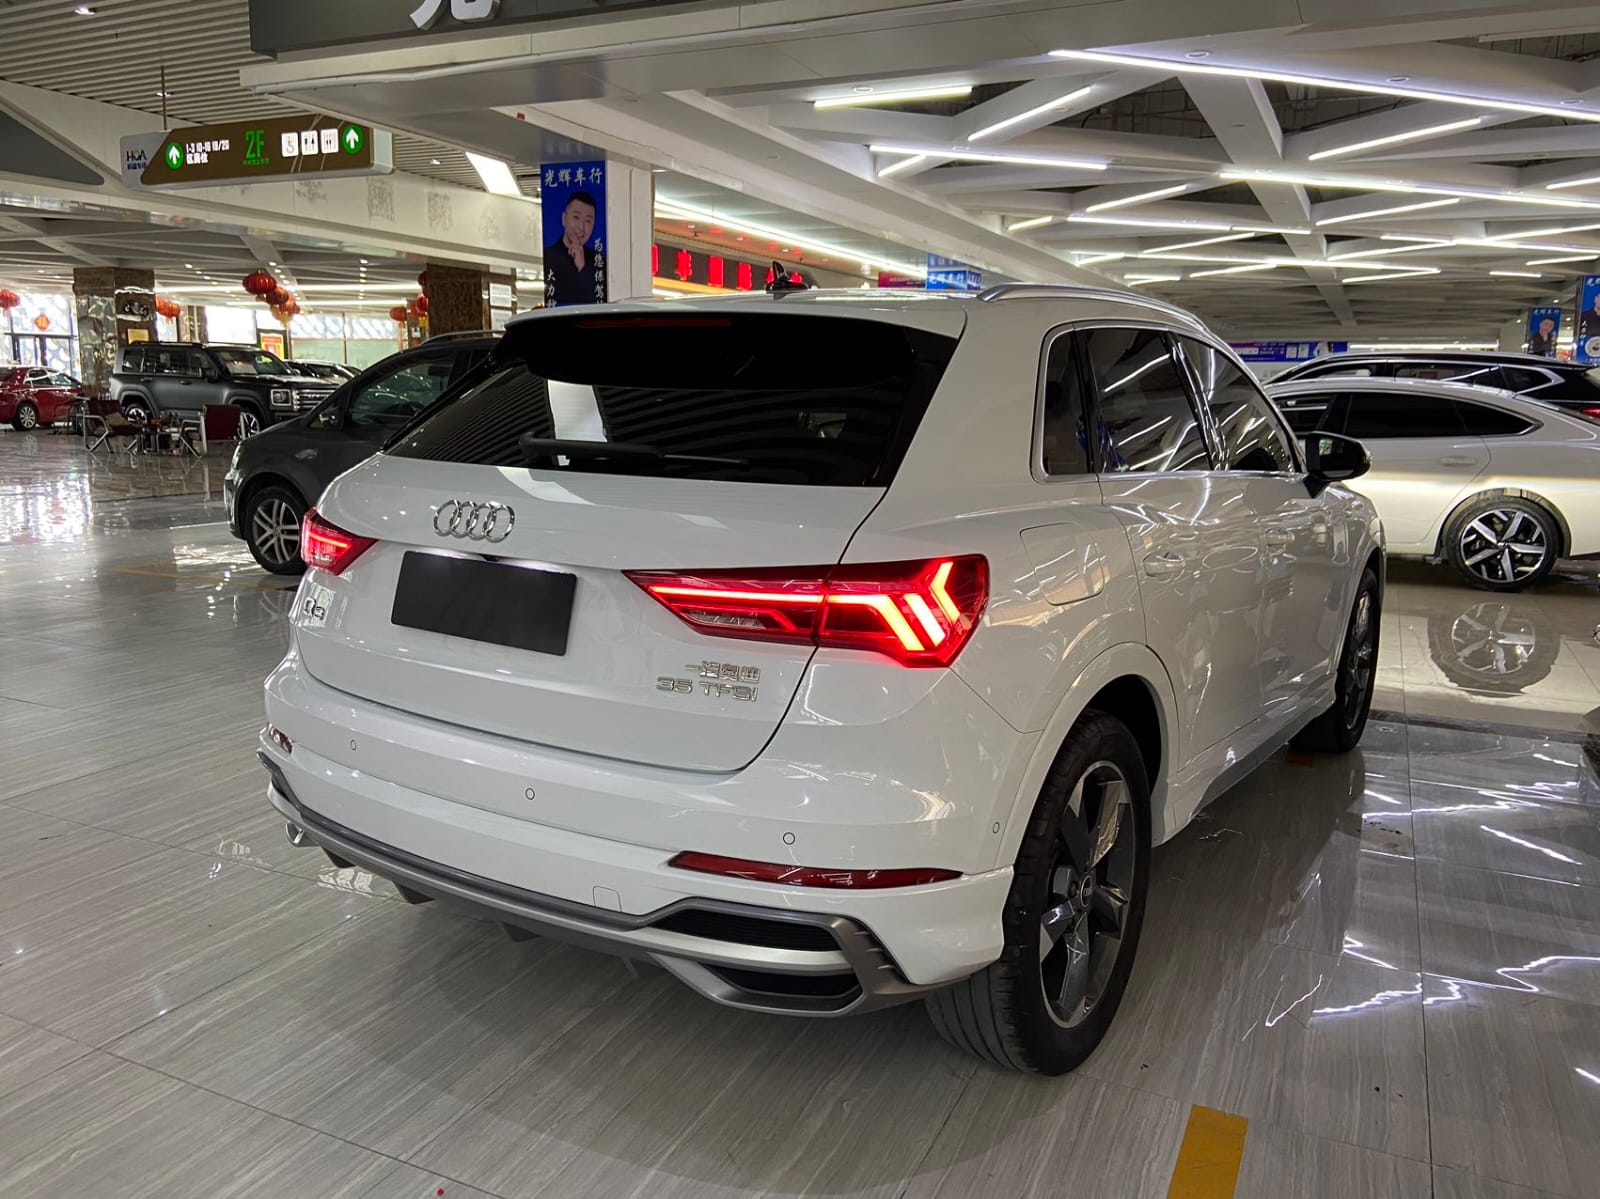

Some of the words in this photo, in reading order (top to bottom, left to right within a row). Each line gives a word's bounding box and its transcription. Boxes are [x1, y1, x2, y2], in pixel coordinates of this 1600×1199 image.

[245, 130, 265, 158] 2F
[656, 677, 693, 693] 35
[699, 681, 758, 702] TFSI
